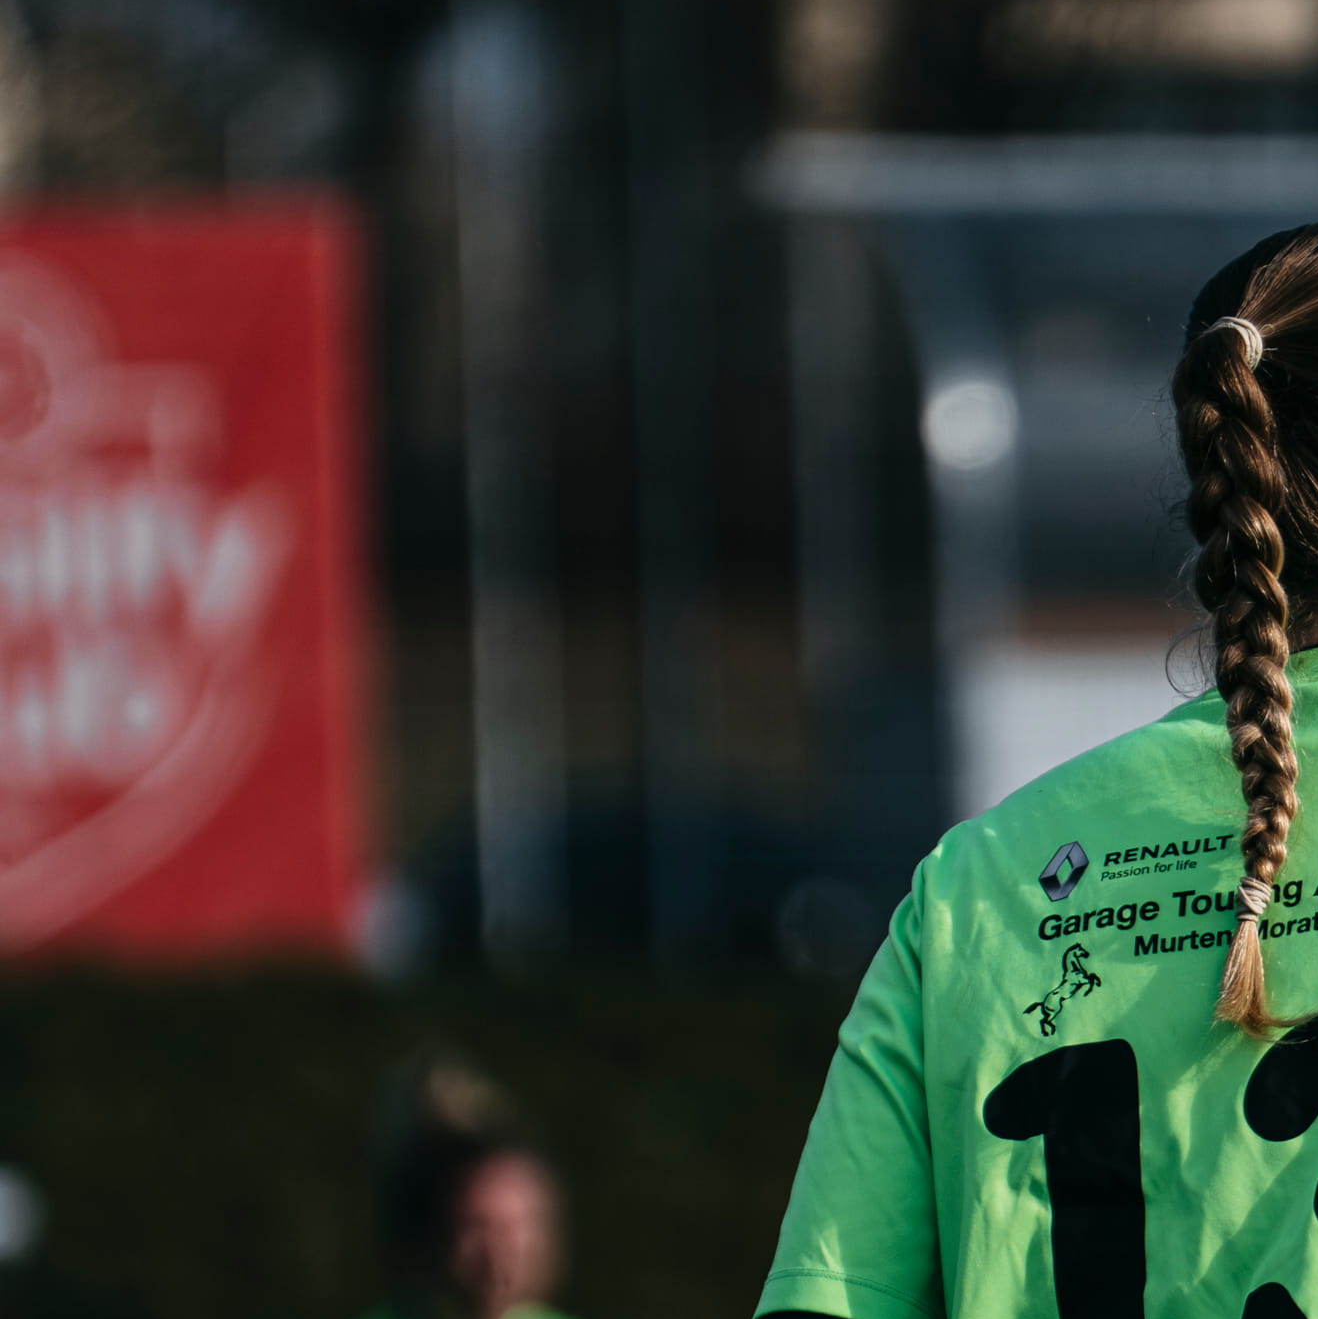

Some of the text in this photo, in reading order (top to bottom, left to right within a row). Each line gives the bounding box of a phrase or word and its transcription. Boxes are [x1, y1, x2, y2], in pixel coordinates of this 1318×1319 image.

[1103, 834, 1234, 867] RENAULT
[1101, 859, 1198, 882] Passion for life
[1038, 898, 1160, 941] Garage
[1172, 879, 1303, 918] Toung
